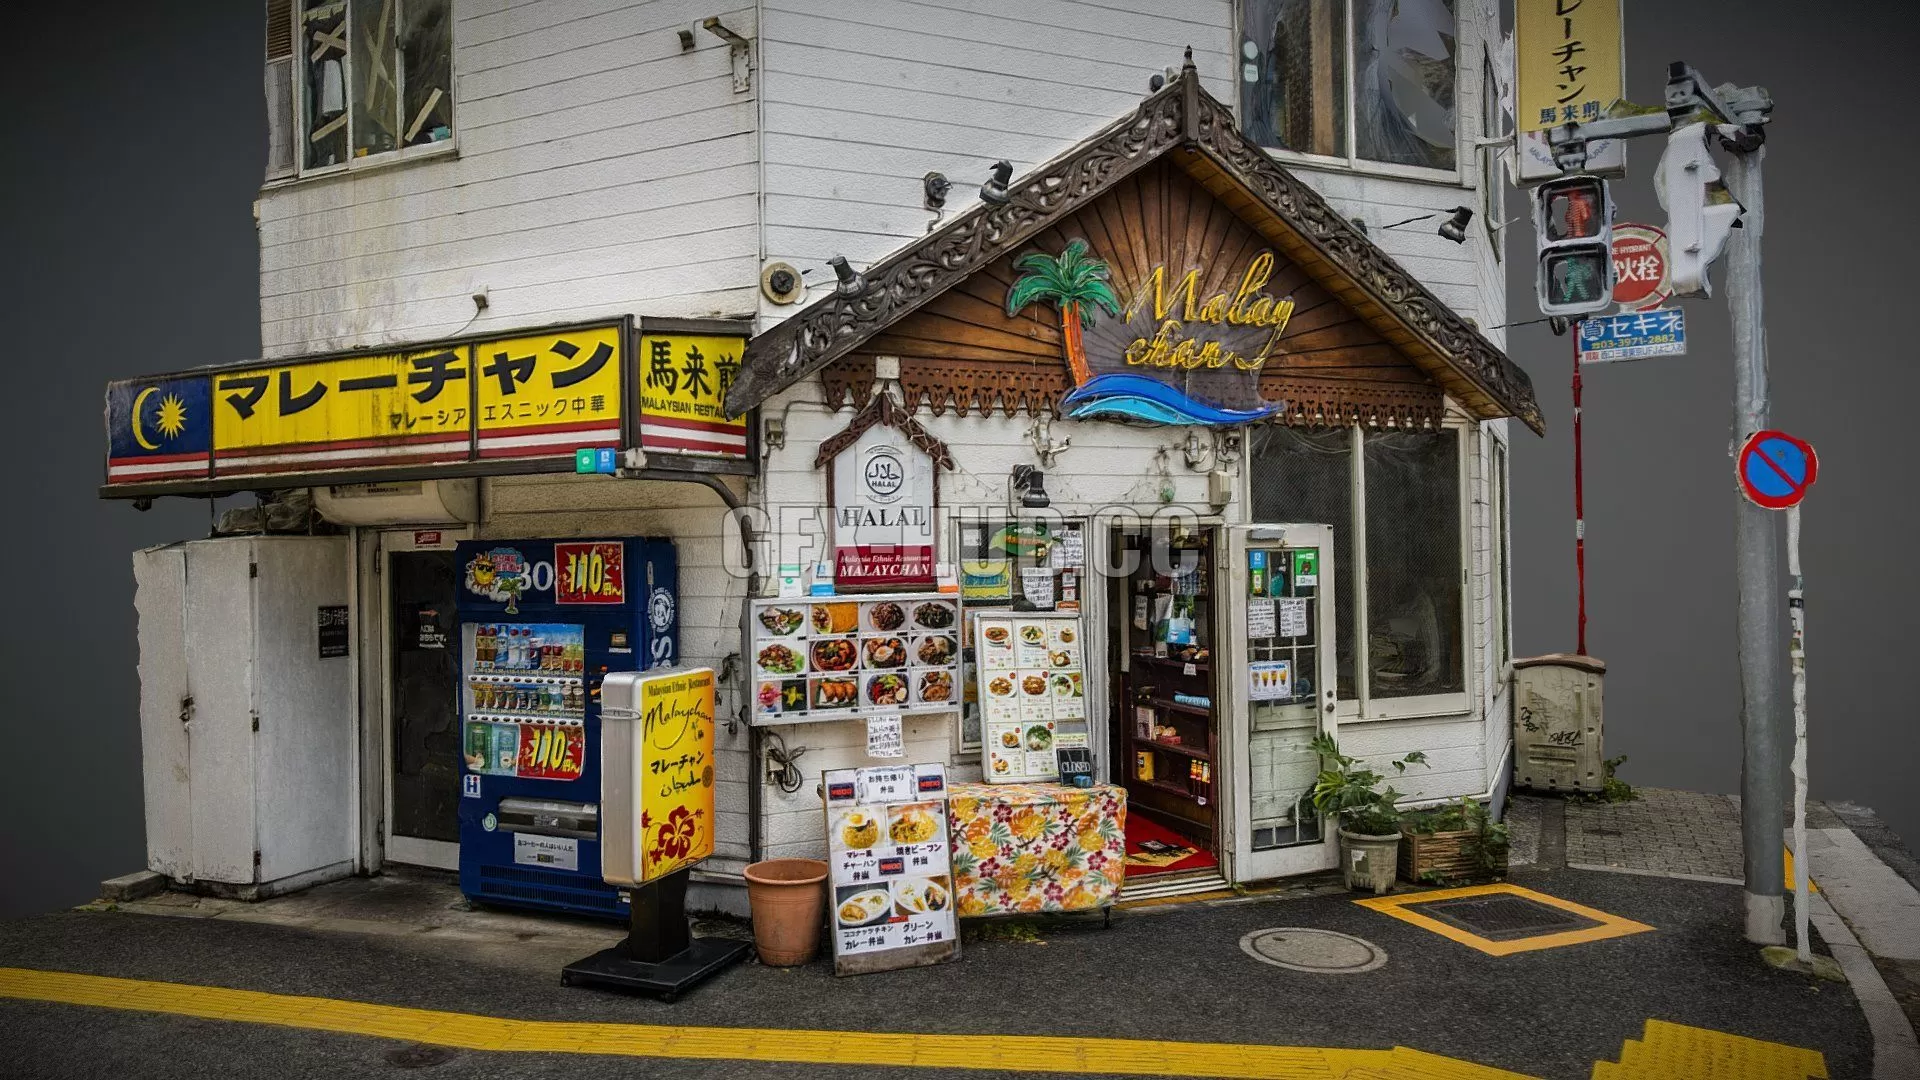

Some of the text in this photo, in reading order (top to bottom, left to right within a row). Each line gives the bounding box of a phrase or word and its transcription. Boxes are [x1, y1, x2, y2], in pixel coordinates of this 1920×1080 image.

[1124, 250, 1296, 369] Malay
[219, 340, 614, 420] マレーチャン
[390, 395, 605, 429] マレーシア エスニック中華
[641, 396, 692, 414] MALAYSIAN
[868, 463, 900, 480] حلال
[871, 480, 896, 488] HALAL
[842, 508, 926, 527] HALAL
[872, 555, 894, 563] Ethnic
[840, 563, 930, 577] MALAYCHAN
[643, 698, 715, 750] Malaychan
[651, 751, 704, 775] マレーチャン
[1062, 761, 1091, 773] CLOSED
[868, 773, 905, 784] お持ち帰り
[880, 785, 895, 795] 弁当
[912, 856, 928, 866] 弁当
[853, 870, 870, 881] 弁当
[902, 921, 934, 932] グリーン
[844, 935, 885, 950] カレー弁当
[903, 930, 943, 945] カレー弁当
